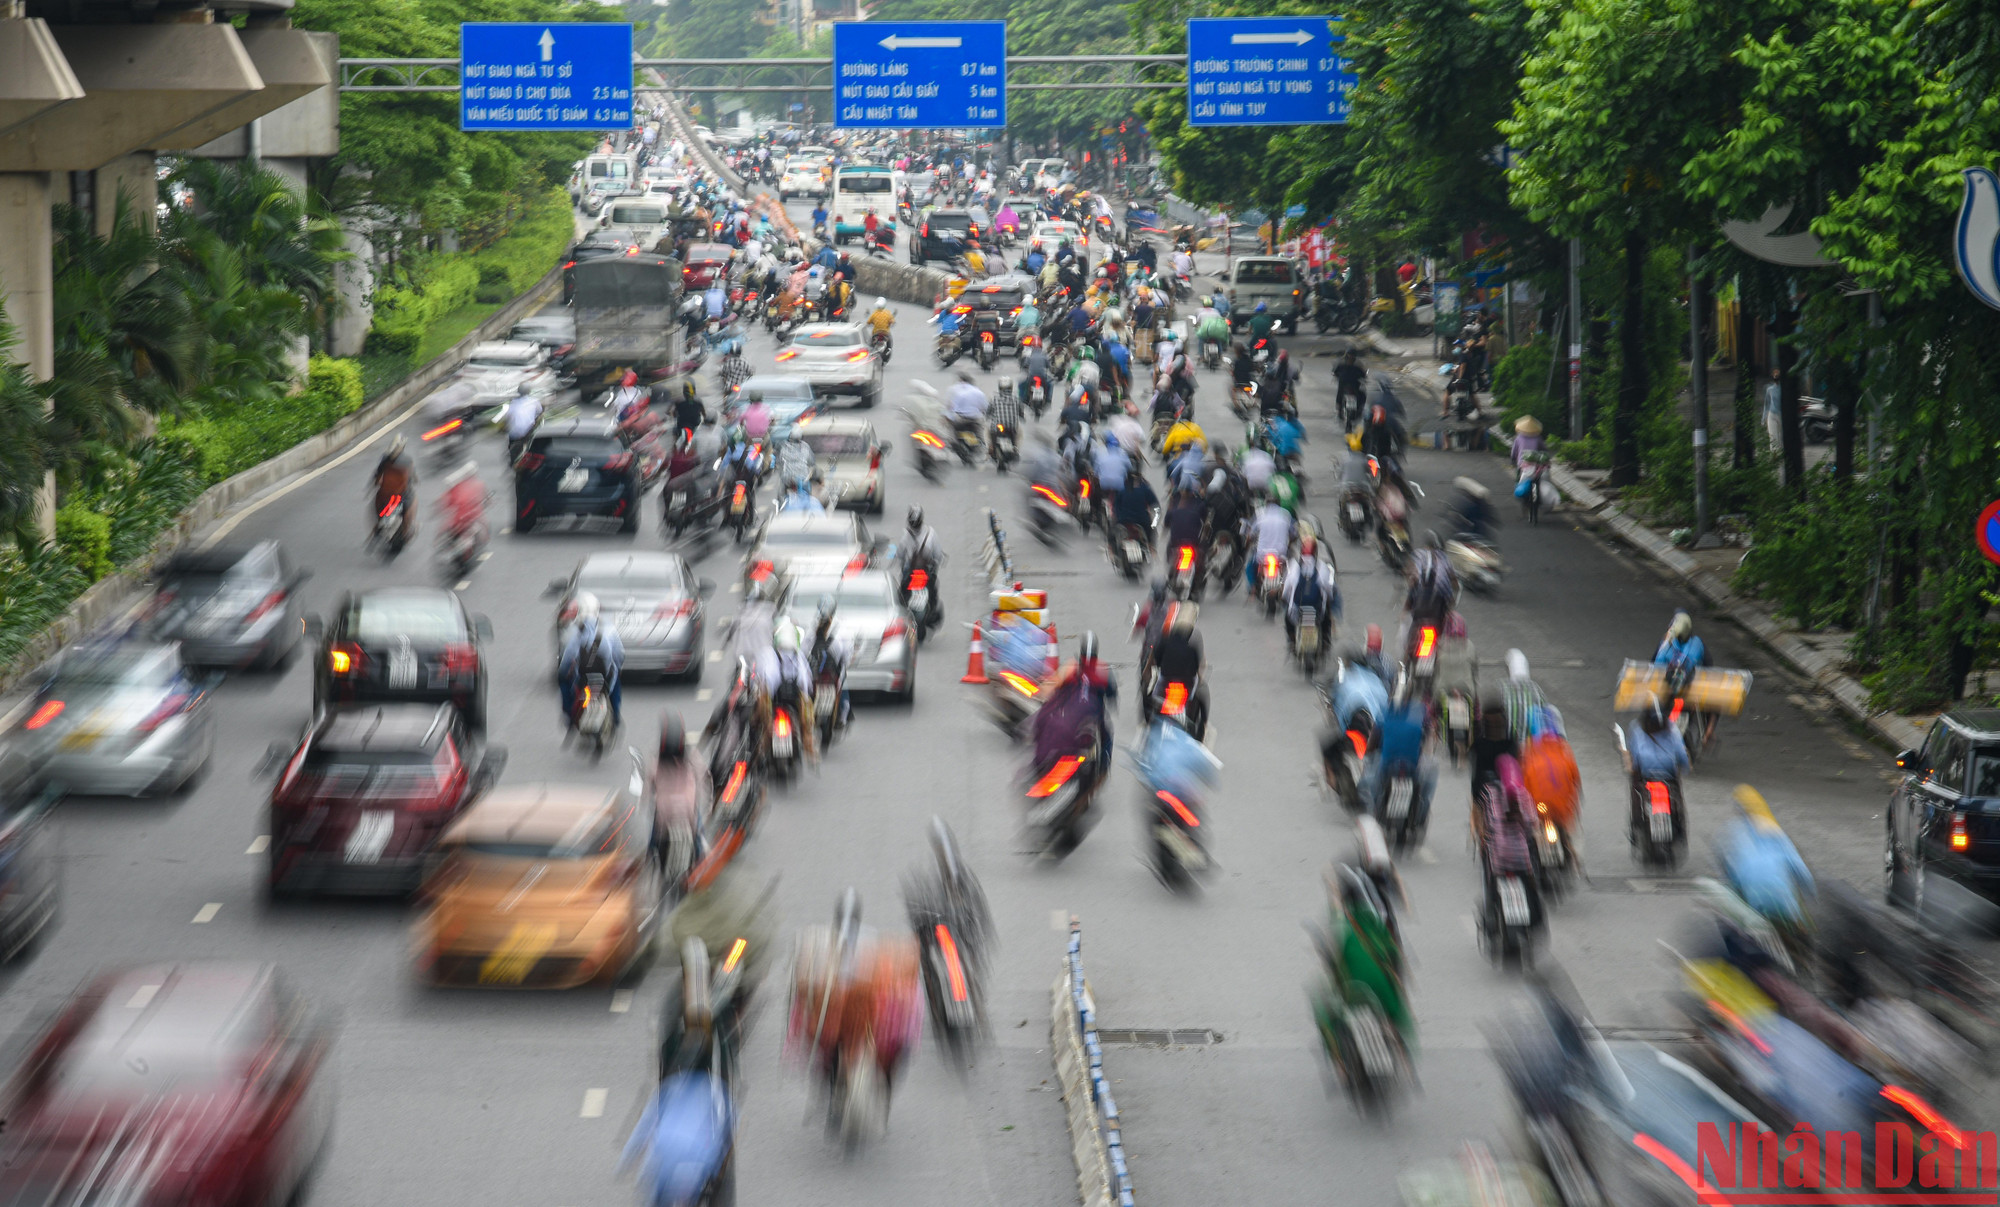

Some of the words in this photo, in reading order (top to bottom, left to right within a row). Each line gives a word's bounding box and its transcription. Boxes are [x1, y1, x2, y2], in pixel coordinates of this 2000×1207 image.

[465, 61, 486, 78] NÚT
[488, 65, 512, 78] GIAO
[515, 62, 536, 78] NGÃ
[540, 65, 554, 78] TƯ
[880, 59, 908, 77] LÁNG
[980, 63, 997, 75] km
[1277, 59, 1308, 72] CHINH
[466, 83, 486, 99] NÚT
[488, 86, 512, 99] GIAO
[515, 84, 523, 99] Ô
[593, 87, 609, 100] 2,5
[612, 87, 629, 99] km
[842, 81, 863, 98] NÚT
[865, 85, 890, 98] GIAO
[970, 84, 978, 98] 5
[980, 84, 997, 97] km
[1194, 78, 1215, 95] NÚT
[1217, 81, 1241, 95] GIAO
[1243, 78, 1264, 94] NGÃ
[1267, 80, 1281, 94] TƯ
[1285, 80, 1312, 95] VỌNG
[1328, 80, 1334, 93] 3
[467, 106, 487, 120] VĂN
[562, 105, 588, 121] GIÁM
[594, 108, 610, 121] 4,3
[612, 109, 629, 121] km
[866, 104, 893, 120] NHẬT
[896, 105, 917, 119] TÂN
[967, 106, 978, 118] 11
[980, 106, 997, 119] km
[1220, 101, 1243, 116] VĨNH
[1246, 103, 1267, 116] TUY
[1328, 101, 1335, 114] 8
